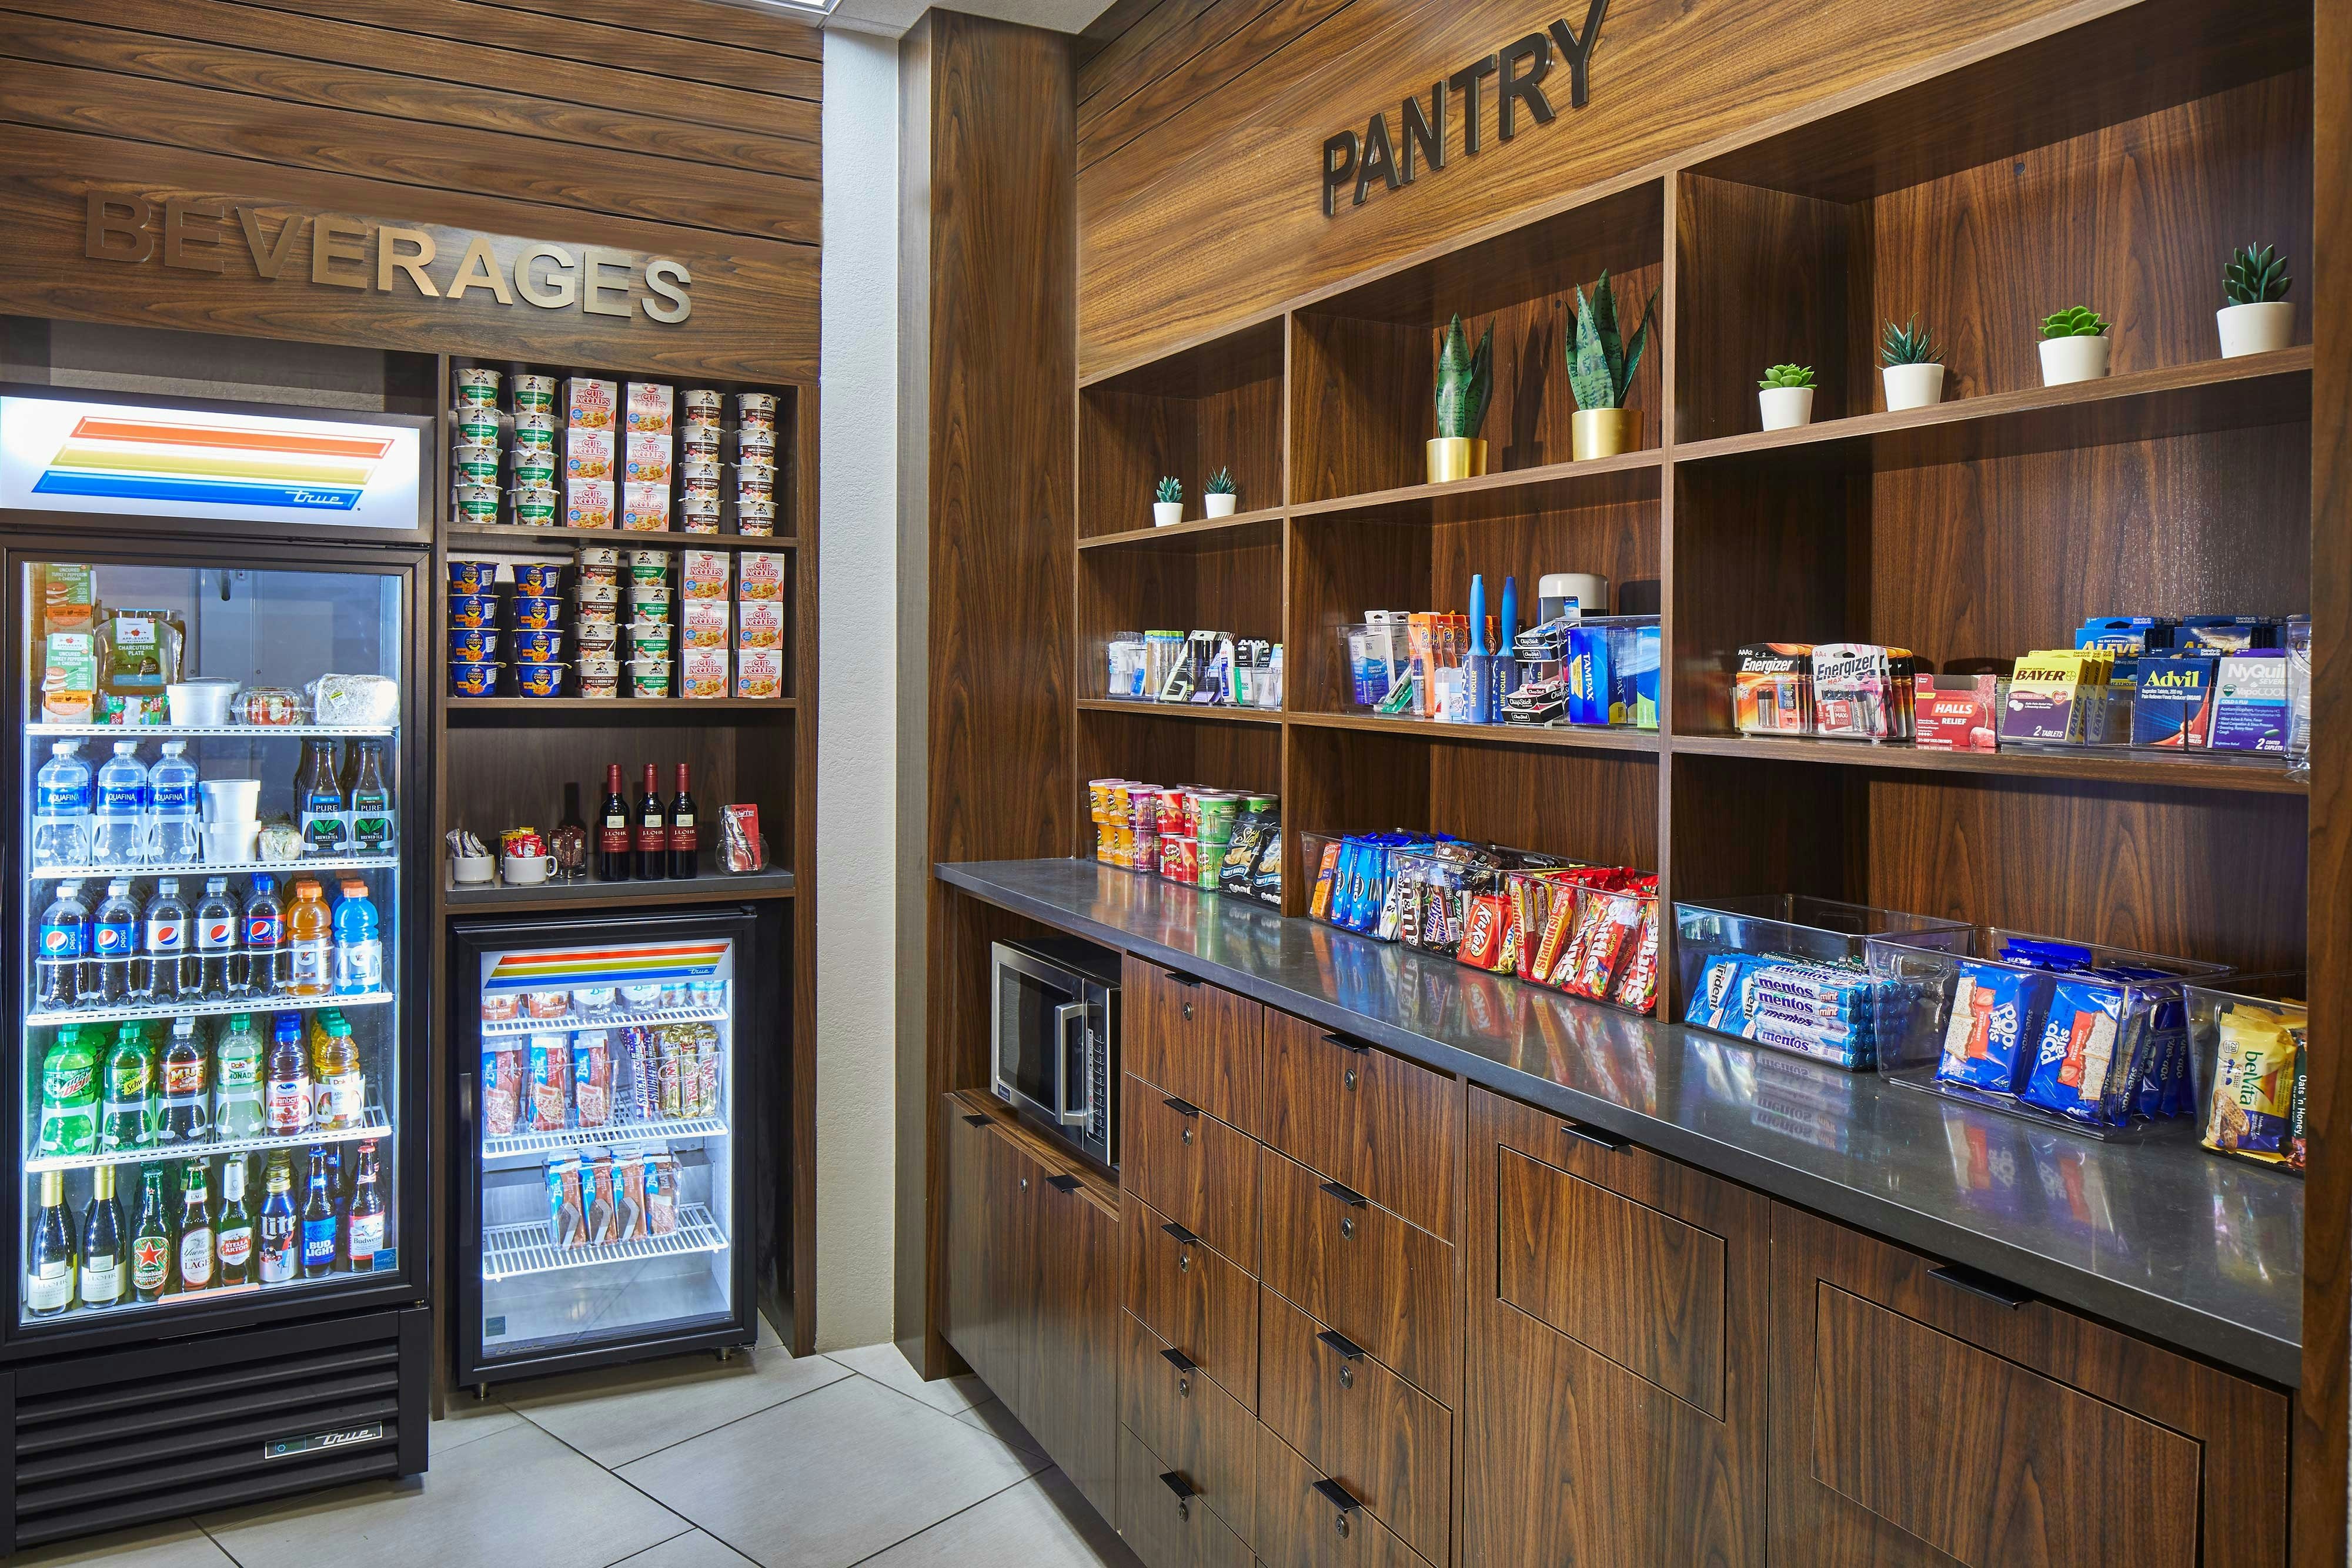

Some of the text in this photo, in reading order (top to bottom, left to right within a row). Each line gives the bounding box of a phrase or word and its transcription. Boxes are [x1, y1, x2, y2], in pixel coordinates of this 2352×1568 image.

[1322, 0, 1610, 216] PANTRY
[85, 189, 693, 323] BEVERAGES
[576, 396, 610, 406] NOODLES
[584, 389, 604, 398] CUP
[573, 447, 608, 456] NOODLES
[632, 450, 666, 459] NOODLES
[285, 490, 344, 505] true
[573, 496, 608, 506] NOODLES
[582, 490, 602, 498] CUP
[690, 567, 724, 576] NOODLES
[746, 569, 779, 577] NOODLES
[746, 618, 778, 626] NOODLES
[2082, 640, 2140, 654] ALEVE
[689, 666, 722, 674] NOODLES
[744, 666, 776, 674] NOODLES
[1742, 657, 1793, 674] Energizer
[1816, 653, 1875, 681] Energizer
[2228, 664, 2286, 682] NyQuil
[1582, 652, 1594, 701] TAMPAX
[2015, 670, 2066, 681] BAYER
[2144, 670, 2200, 687] Advil
[1935, 704, 1973, 714] HALLS
[2069, 695, 2082, 736] BAYER
[2093, 696, 2106, 736] BAYER
[2033, 726, 2042, 736] 2
[2256, 738, 2265, 750] 2
[1552, 891, 1562, 913] Original
[1512, 889, 1525, 948] Starburst
[1535, 915, 1560, 970] Starburst
[1763, 952, 1799, 964] breathsavers
[1774, 965, 1832, 982] mentos
[1709, 961, 1728, 1011] Trident
[1758, 977, 1839, 1002] mentos mint
[1758, 991, 1839, 1017] mentos mint
[1763, 1008, 1815, 1027] mentos
[1989, 1009, 2002, 1042] tarts
[1761, 1029, 1810, 1052] mentos
[2055, 1028, 2070, 1060] tarts
[2072, 1029, 2083, 1061] STRAWBERRY
[2231, 1041, 2239, 1053] 230
[170, 1066, 204, 1082] MUG
[222, 1071, 255, 1081] LMONAD
[647, 1060, 659, 1101] SNICKERS
[2239, 1050, 2264, 1106] belVita
[2298, 1075, 2307, 1095] Oats
[2294, 1105, 2306, 1135] Honey
[226, 1240, 249, 1248] STELLA
[226, 1245, 249, 1253] ARTOIS
[306, 1245, 335, 1257] LIGHT
[309, 1239, 331, 1250] BUD
[185, 1256, 214, 1270] LAGER
